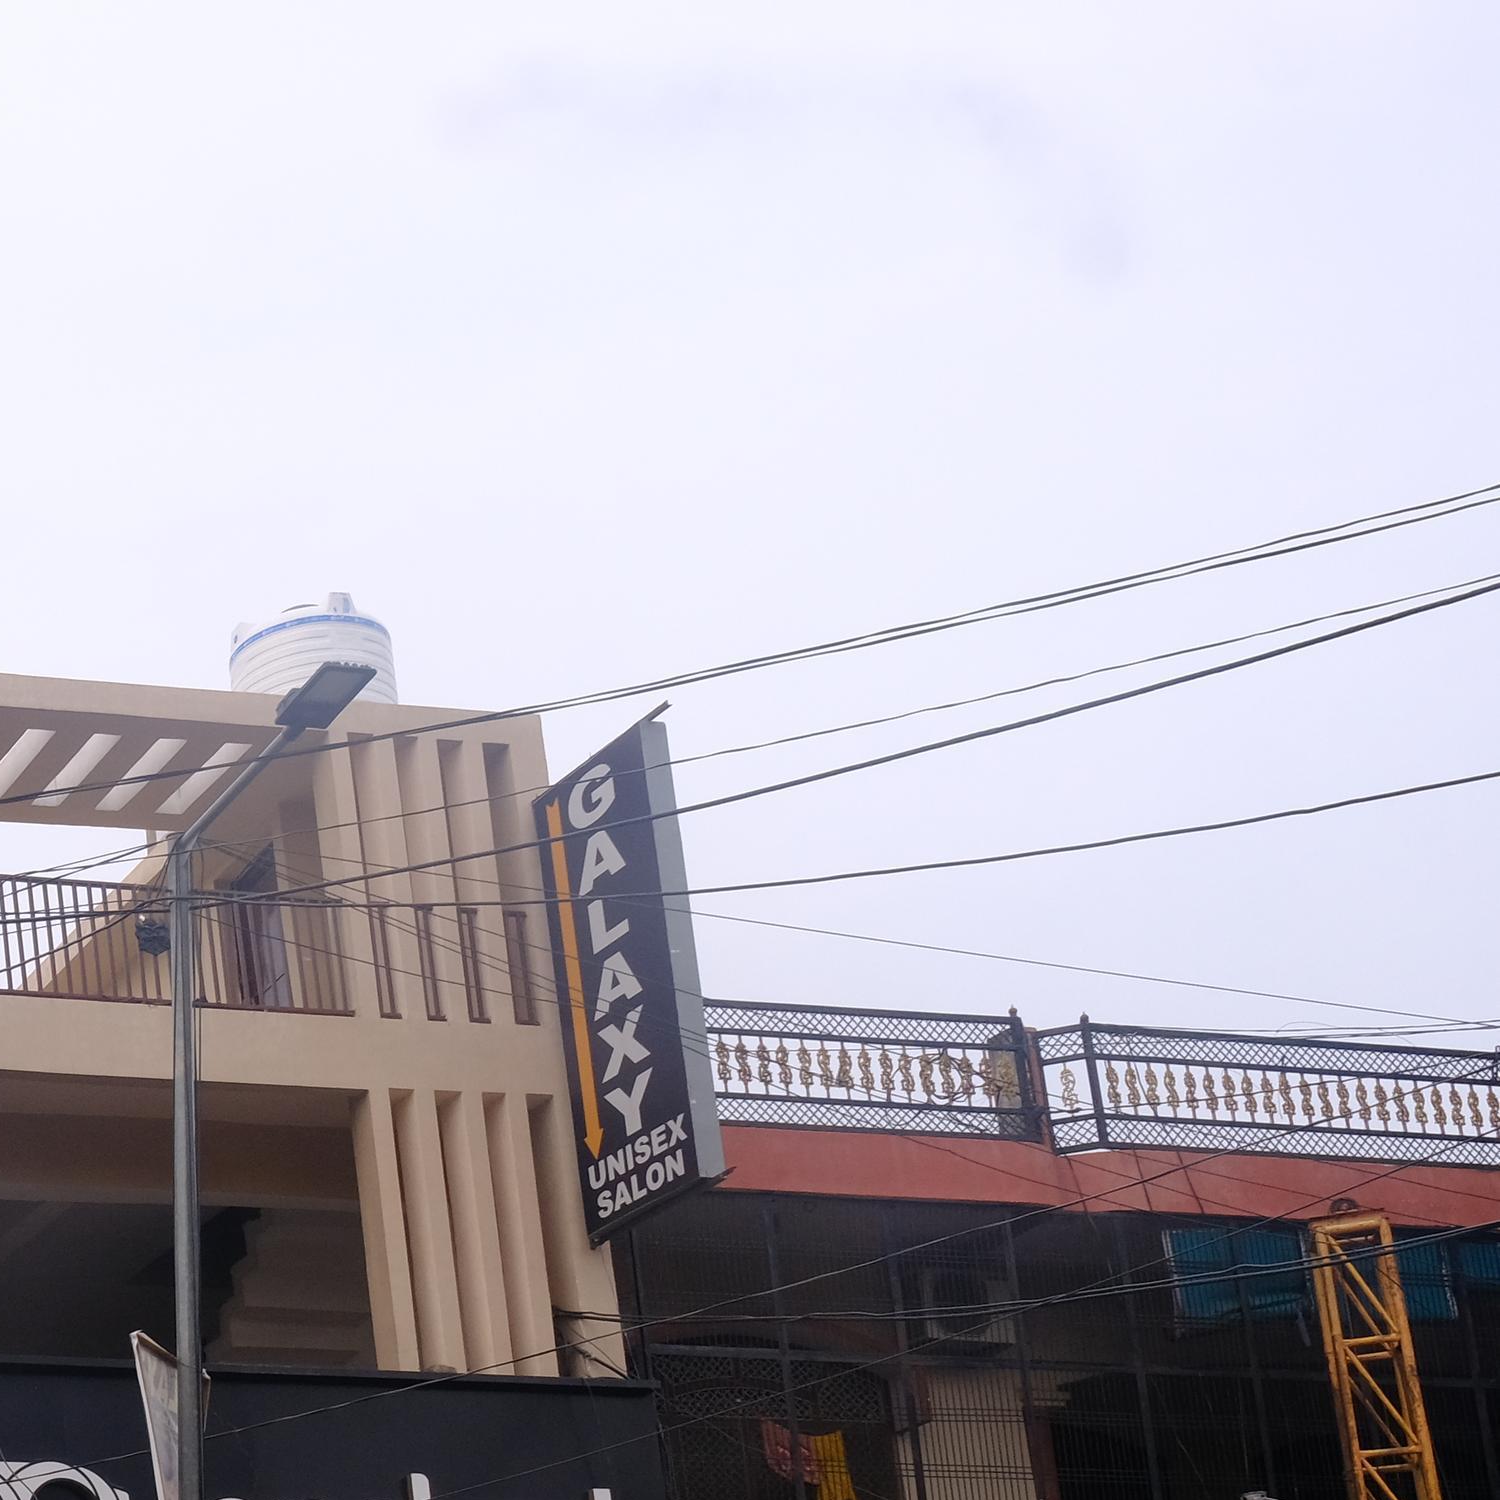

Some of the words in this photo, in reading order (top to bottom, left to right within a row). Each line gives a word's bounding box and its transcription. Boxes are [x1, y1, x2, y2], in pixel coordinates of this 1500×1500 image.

[567, 762, 654, 1137] GALAXY
[587, 1113, 688, 1191] UNISEX
[597, 1149, 686, 1220] SALON
